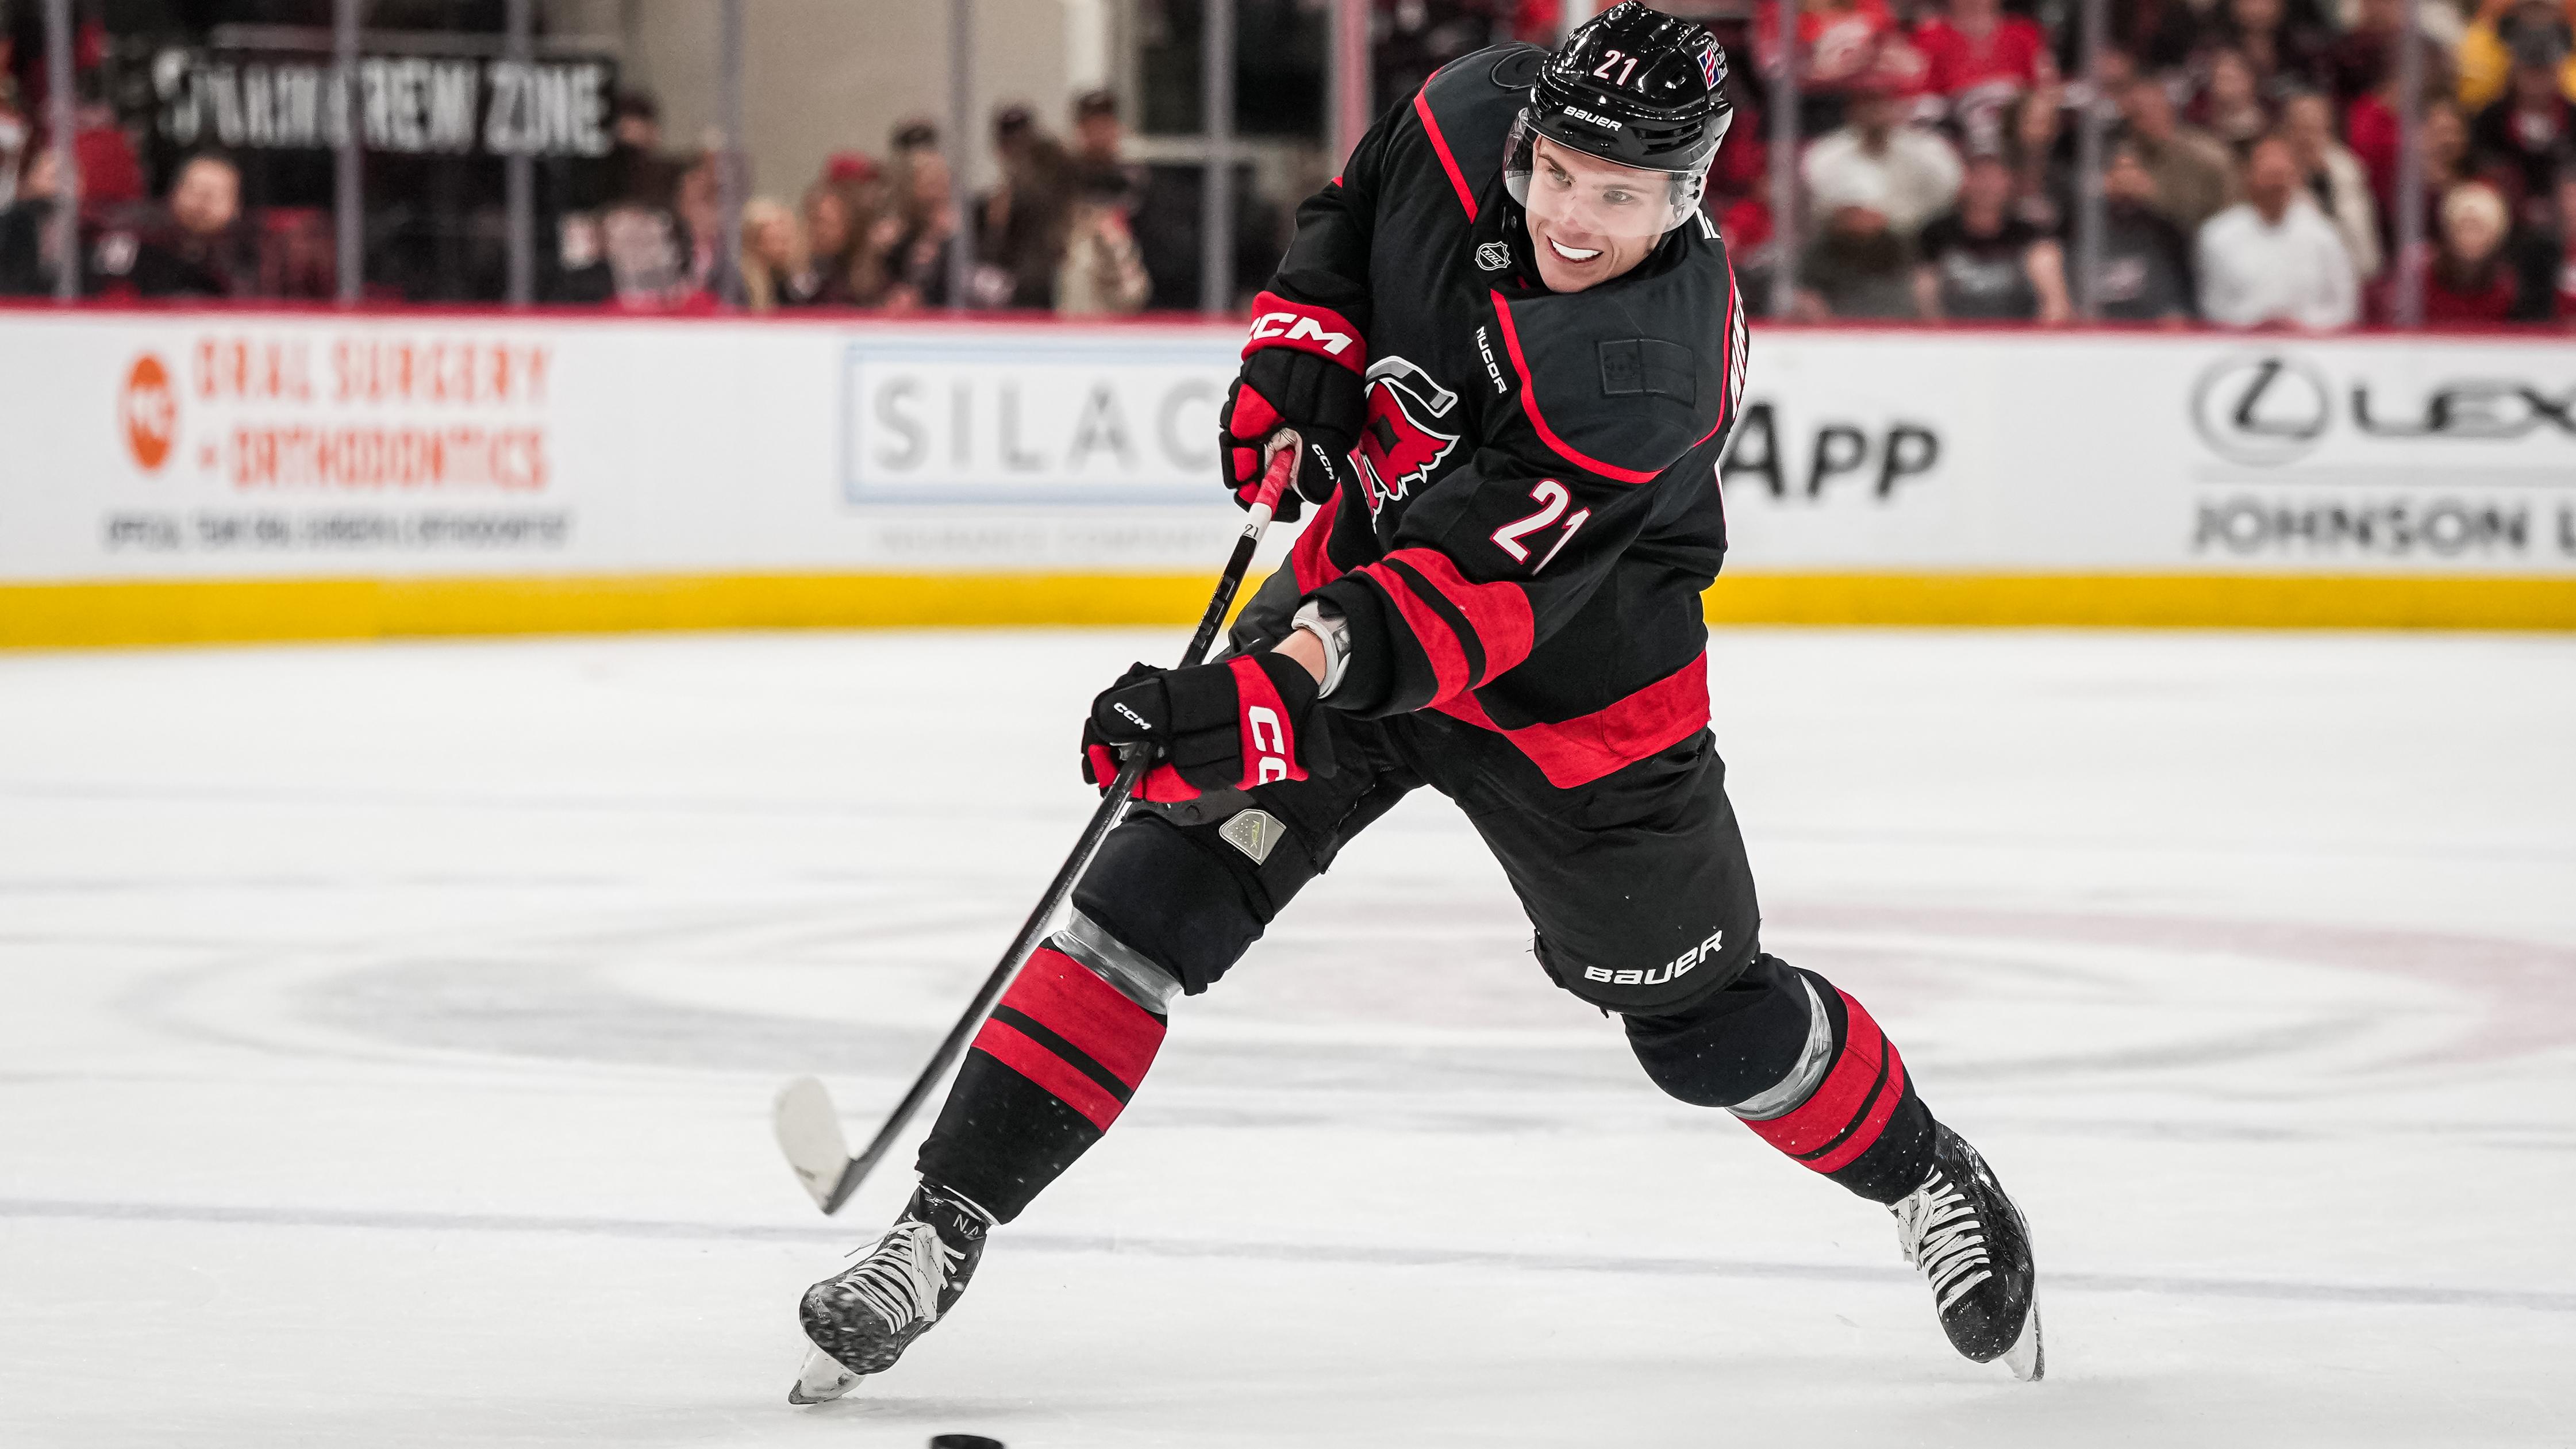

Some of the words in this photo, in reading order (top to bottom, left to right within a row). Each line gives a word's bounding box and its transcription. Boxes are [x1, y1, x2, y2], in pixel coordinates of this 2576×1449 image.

[1593, 49, 1639, 86] 21
[1563, 105, 1623, 132] BAUER
[1482, 249, 1501, 264] NHL
[1476, 326, 1507, 394] NUCOR
[872, 375, 1221, 474] SILAC
[1312, 444, 1335, 480] CCM
[1241, 524, 1259, 538] 21
[1489, 478, 1591, 576] 21
[2193, 500, 2529, 555] JOHNSON
[1113, 702, 1152, 730] CCM
[1584, 930, 1723, 985] BAUER
